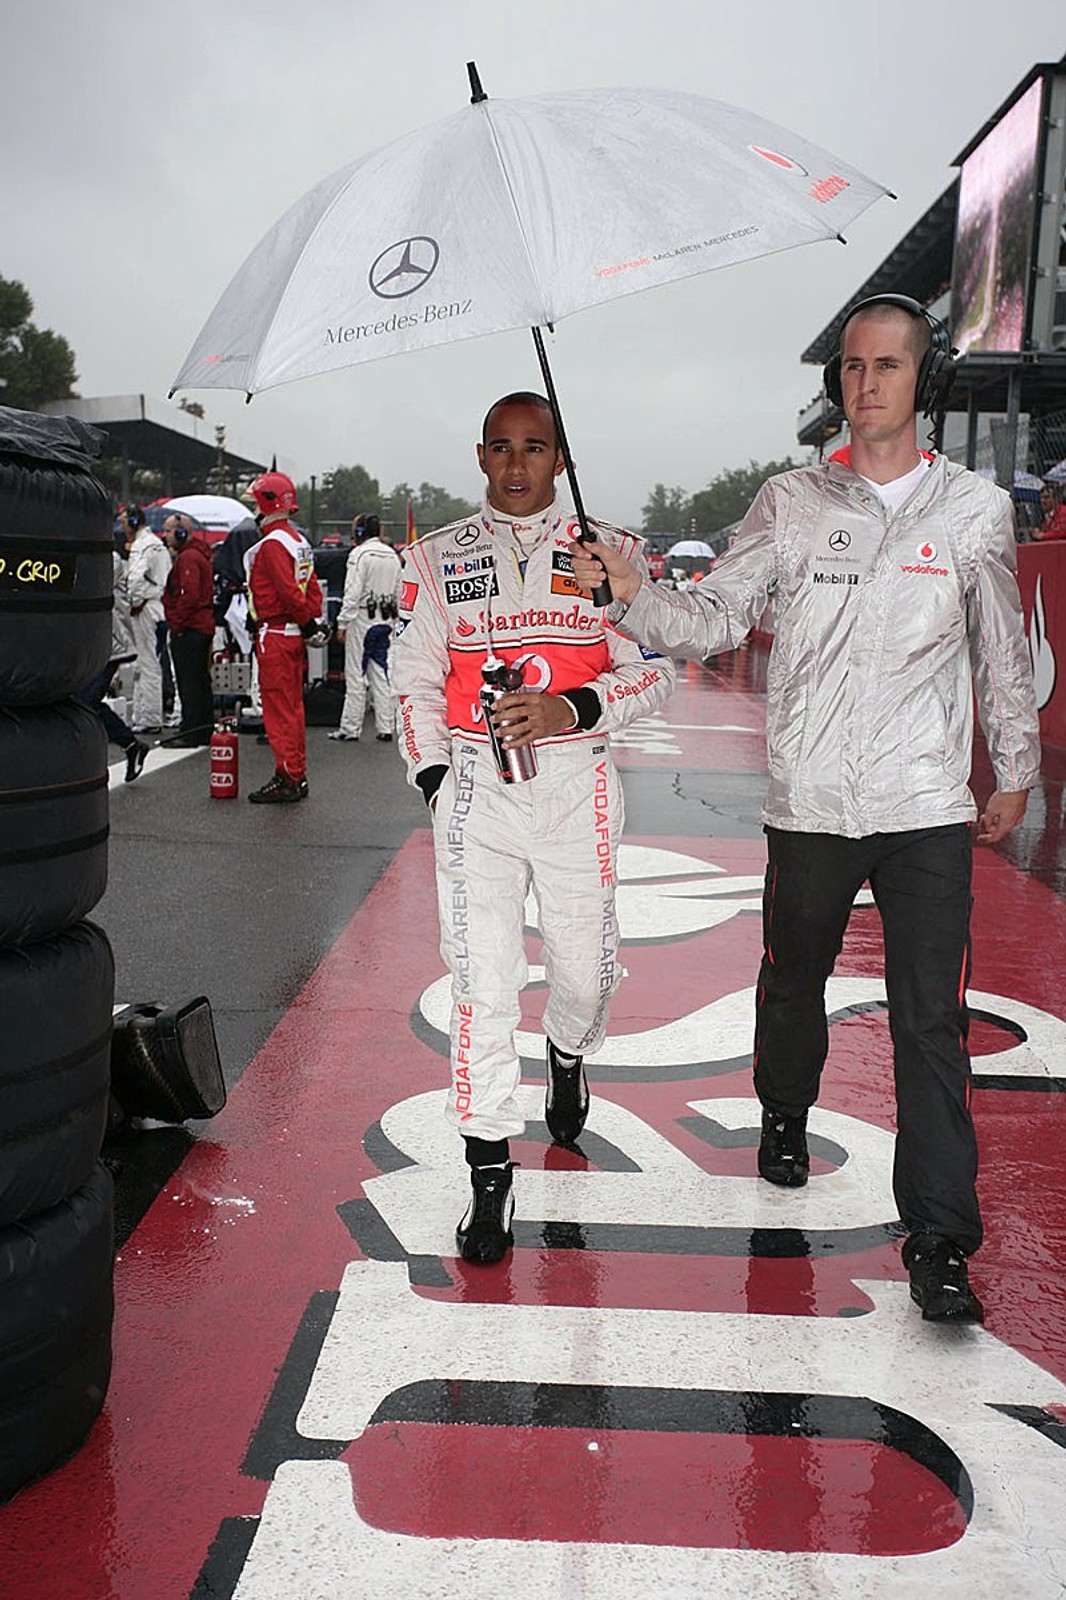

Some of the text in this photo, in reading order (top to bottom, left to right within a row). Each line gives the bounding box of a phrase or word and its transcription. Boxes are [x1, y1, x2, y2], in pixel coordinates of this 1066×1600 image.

[703, 225, 759, 247] MERCEDES
[324, 299, 473, 346] Mercedes-Benz
[443, 559, 480, 576] Mobil
[813, 572, 846, 585] Mobil
[900, 564, 949, 576] vodafone
[478, 604, 599, 633] Santander
[447, 759, 476, 868] MERCEDES
[594, 761, 614, 888] VODAFONE
[453, 879, 470, 995] McLAREN
[455, 1003, 476, 1122] VODAFONE
